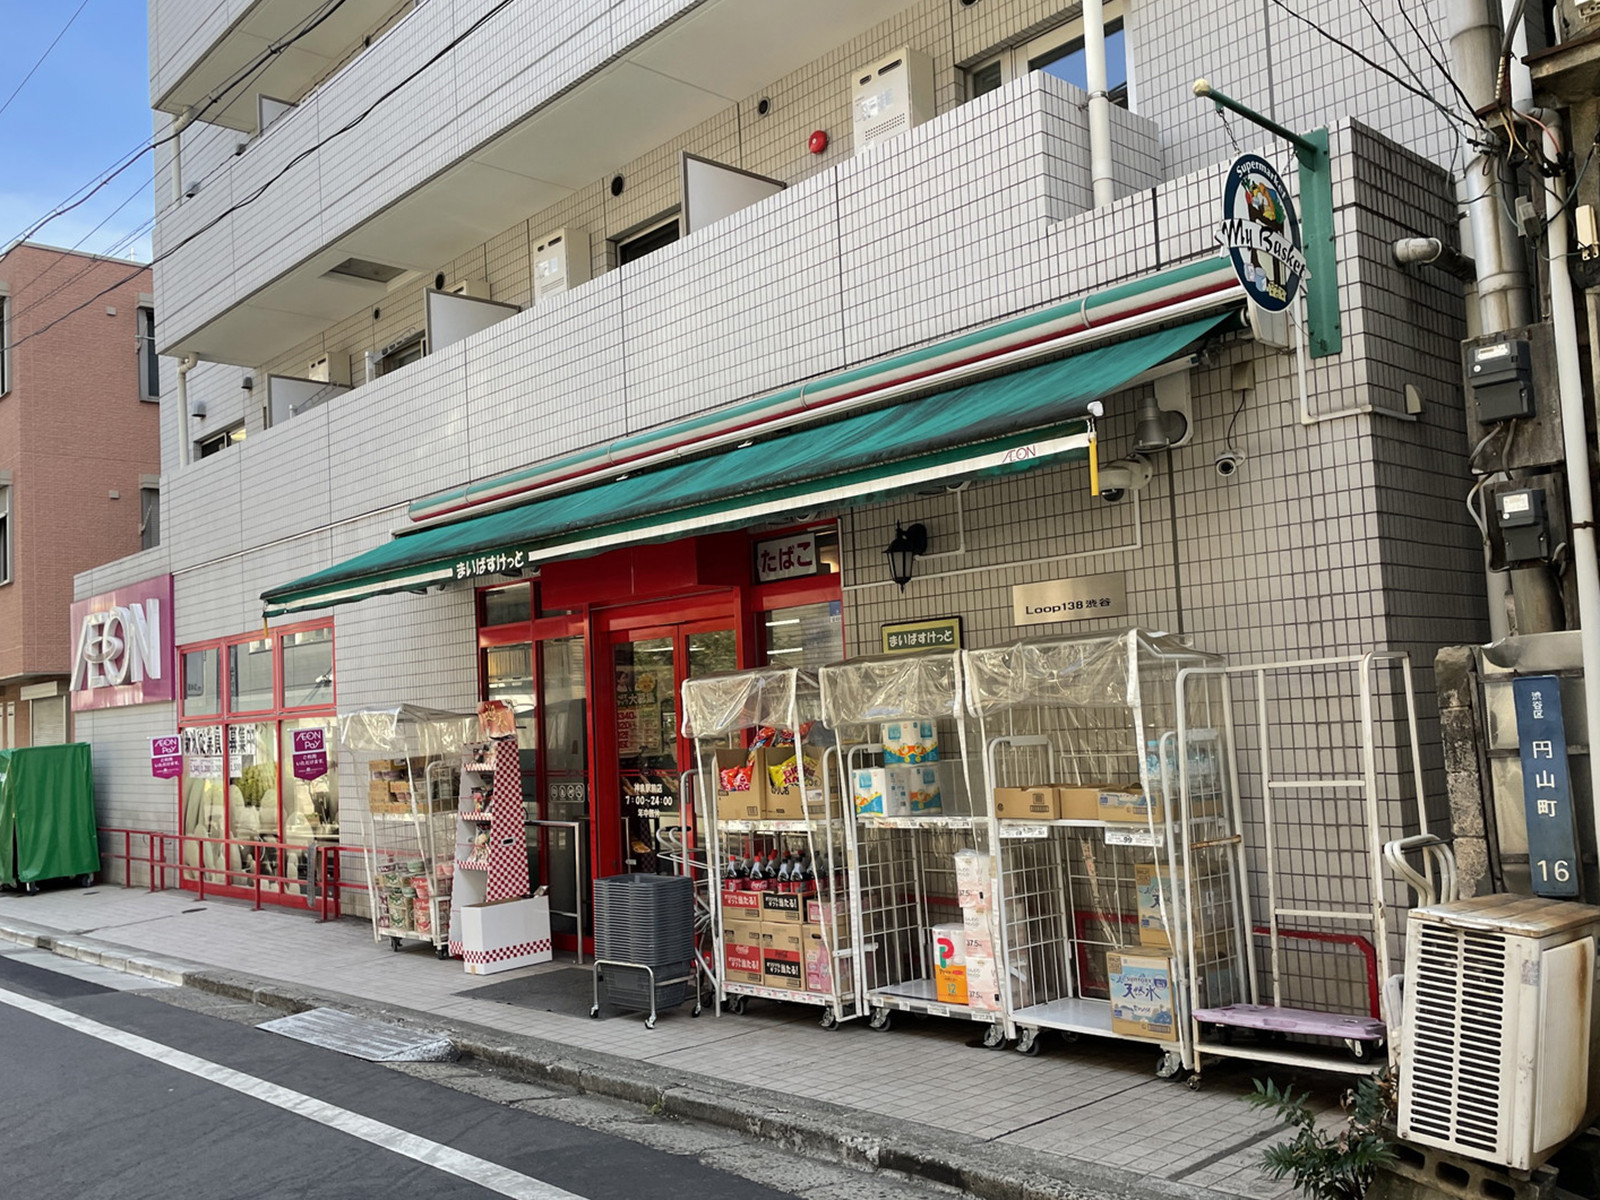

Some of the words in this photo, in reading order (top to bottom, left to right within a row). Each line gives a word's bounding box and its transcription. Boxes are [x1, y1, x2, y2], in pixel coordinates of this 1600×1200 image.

[1236, 160, 1287, 199] Supermarket
[1222, 218, 1253, 250] My
[1259, 226, 1306, 279] Basket
[456, 551, 524, 579] まいばすけっと
[760, 541, 813, 573] たばこ
[889, 629, 953, 647] まいばすけっと
[1531, 691, 1544, 719] 渋谷区
[304, 740, 321, 750] Pay
[1533, 740, 1557, 817] 円山町
[1537, 859, 1570, 882] 16
